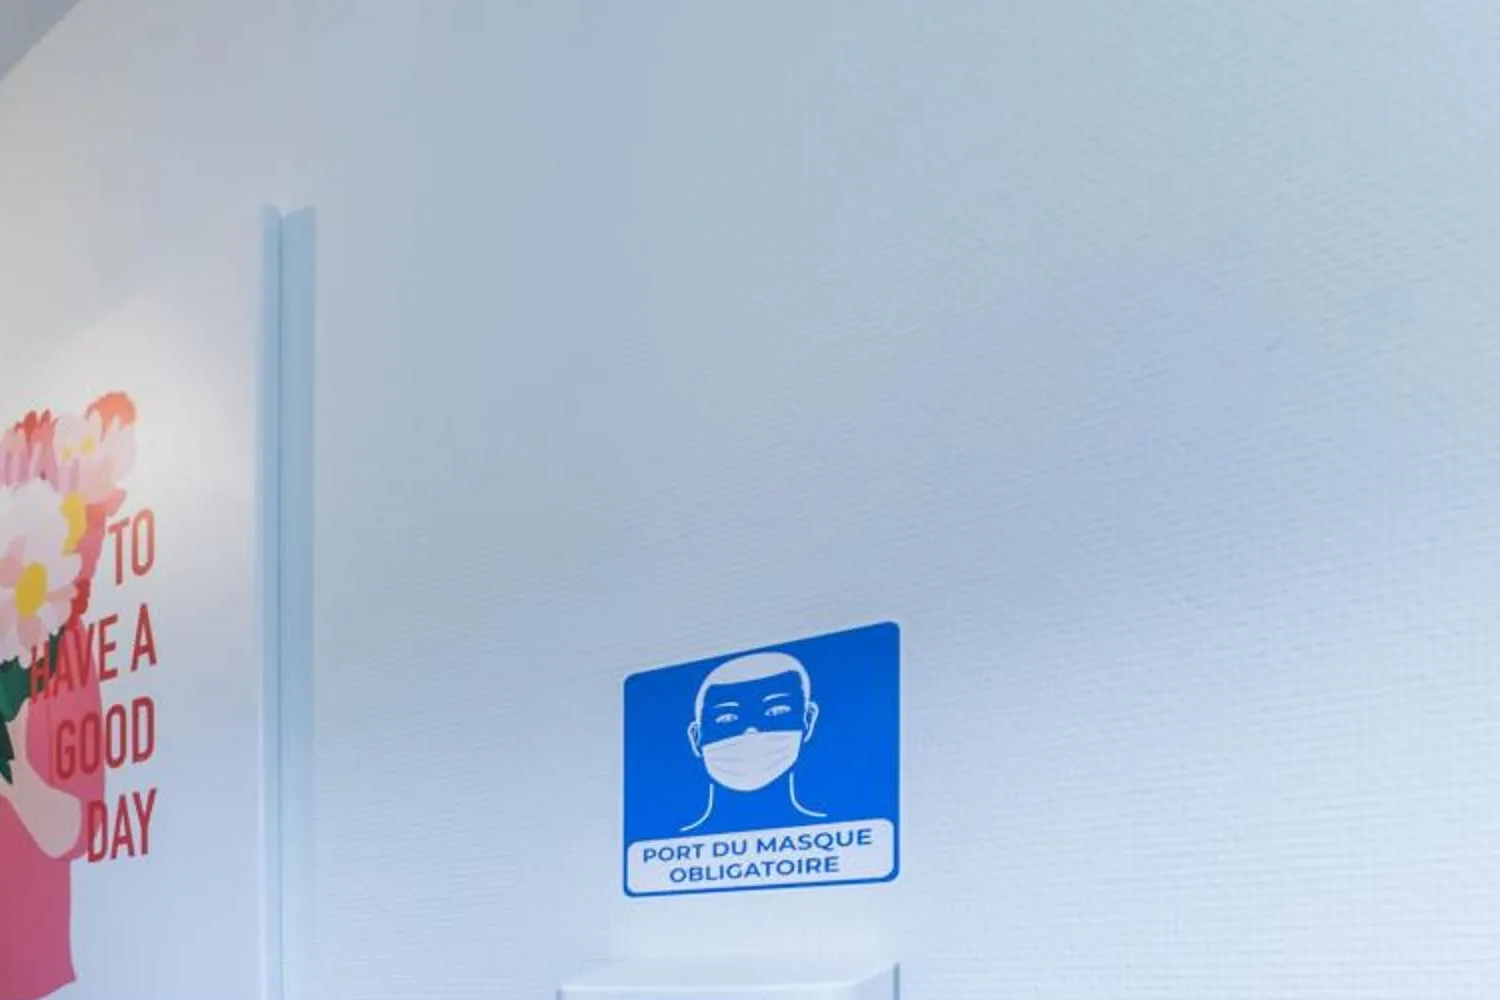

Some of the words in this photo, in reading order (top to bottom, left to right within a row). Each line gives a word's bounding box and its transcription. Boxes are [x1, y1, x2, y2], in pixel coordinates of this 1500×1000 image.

[109, 508, 156, 586] TO
[30, 614, 119, 704] HAVE
[130, 603, 157, 673] A
[55, 696, 156, 780] GOOD
[87, 788, 158, 863] DAY
[643, 843, 705, 863] PORT
[712, 839, 748, 858] DU
[756, 828, 873, 853] MASQUE
[669, 855, 841, 884] OBLIGATOIRE
